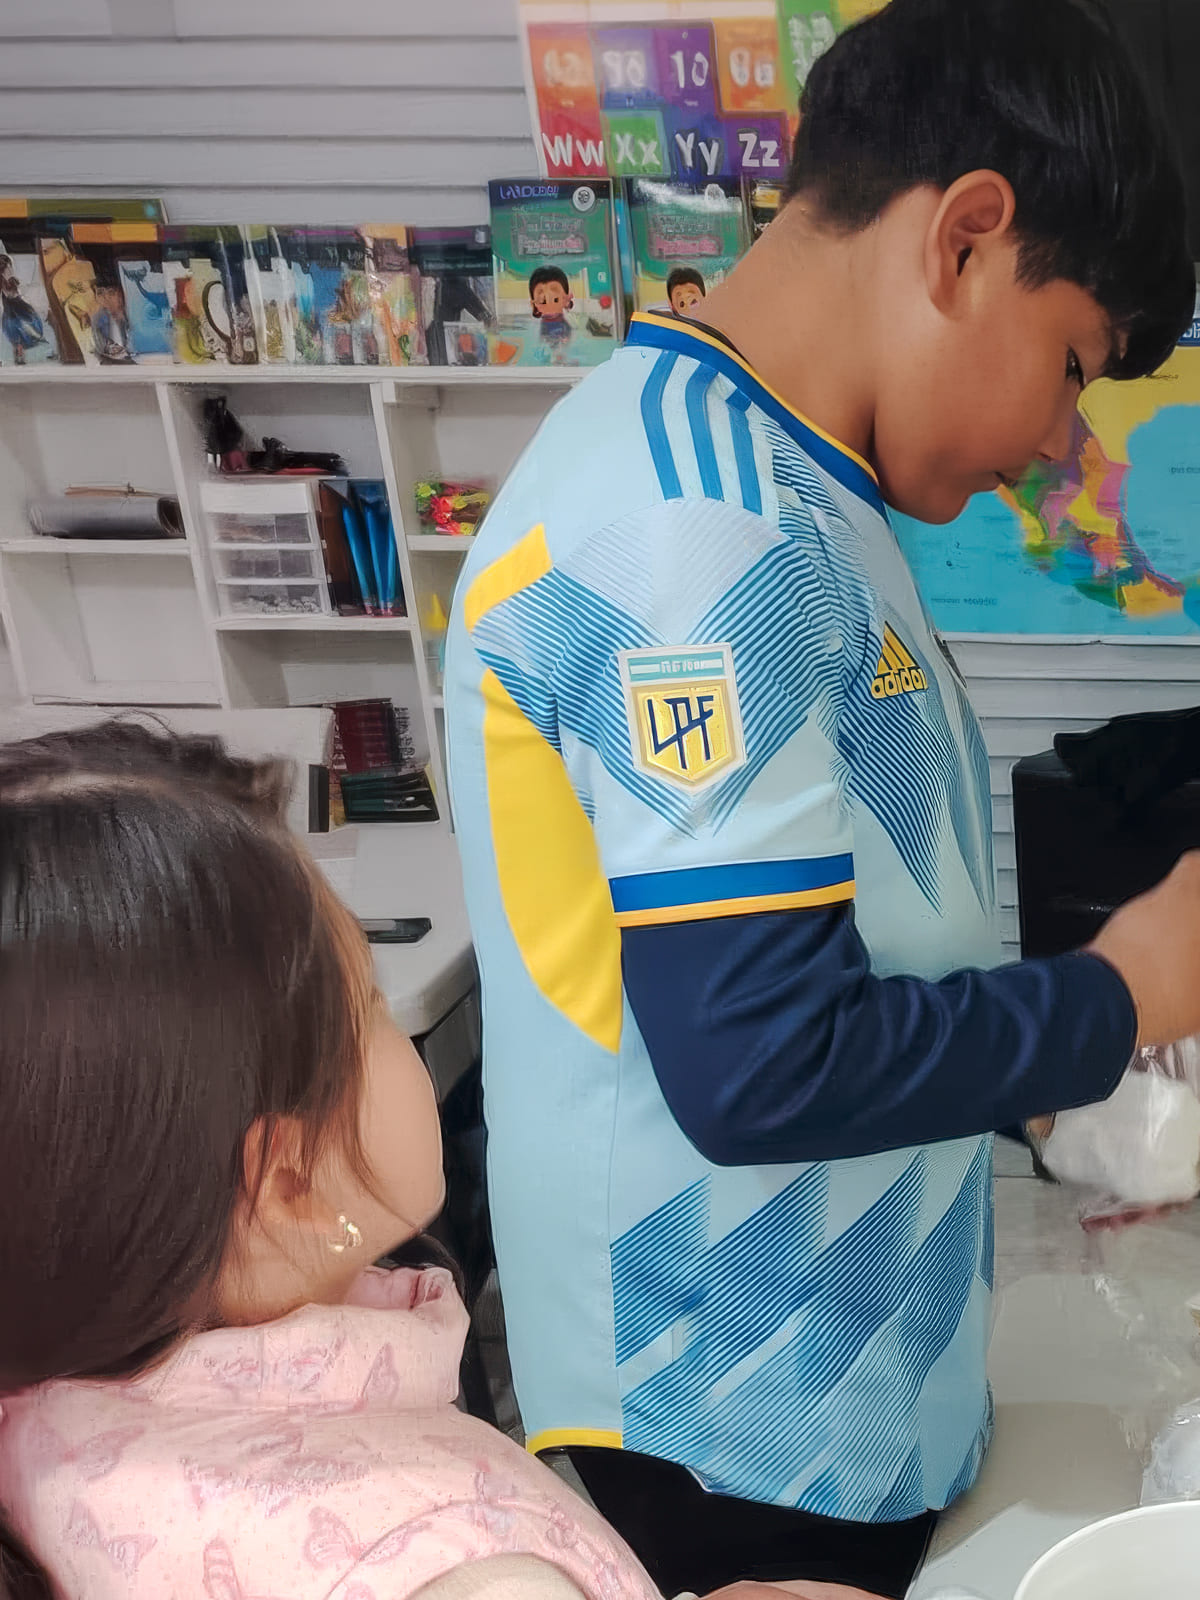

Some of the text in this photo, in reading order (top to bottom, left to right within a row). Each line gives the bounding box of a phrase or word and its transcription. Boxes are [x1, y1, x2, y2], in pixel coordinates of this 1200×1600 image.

[540, 130, 780, 176] Ww Xx Yy Zz
